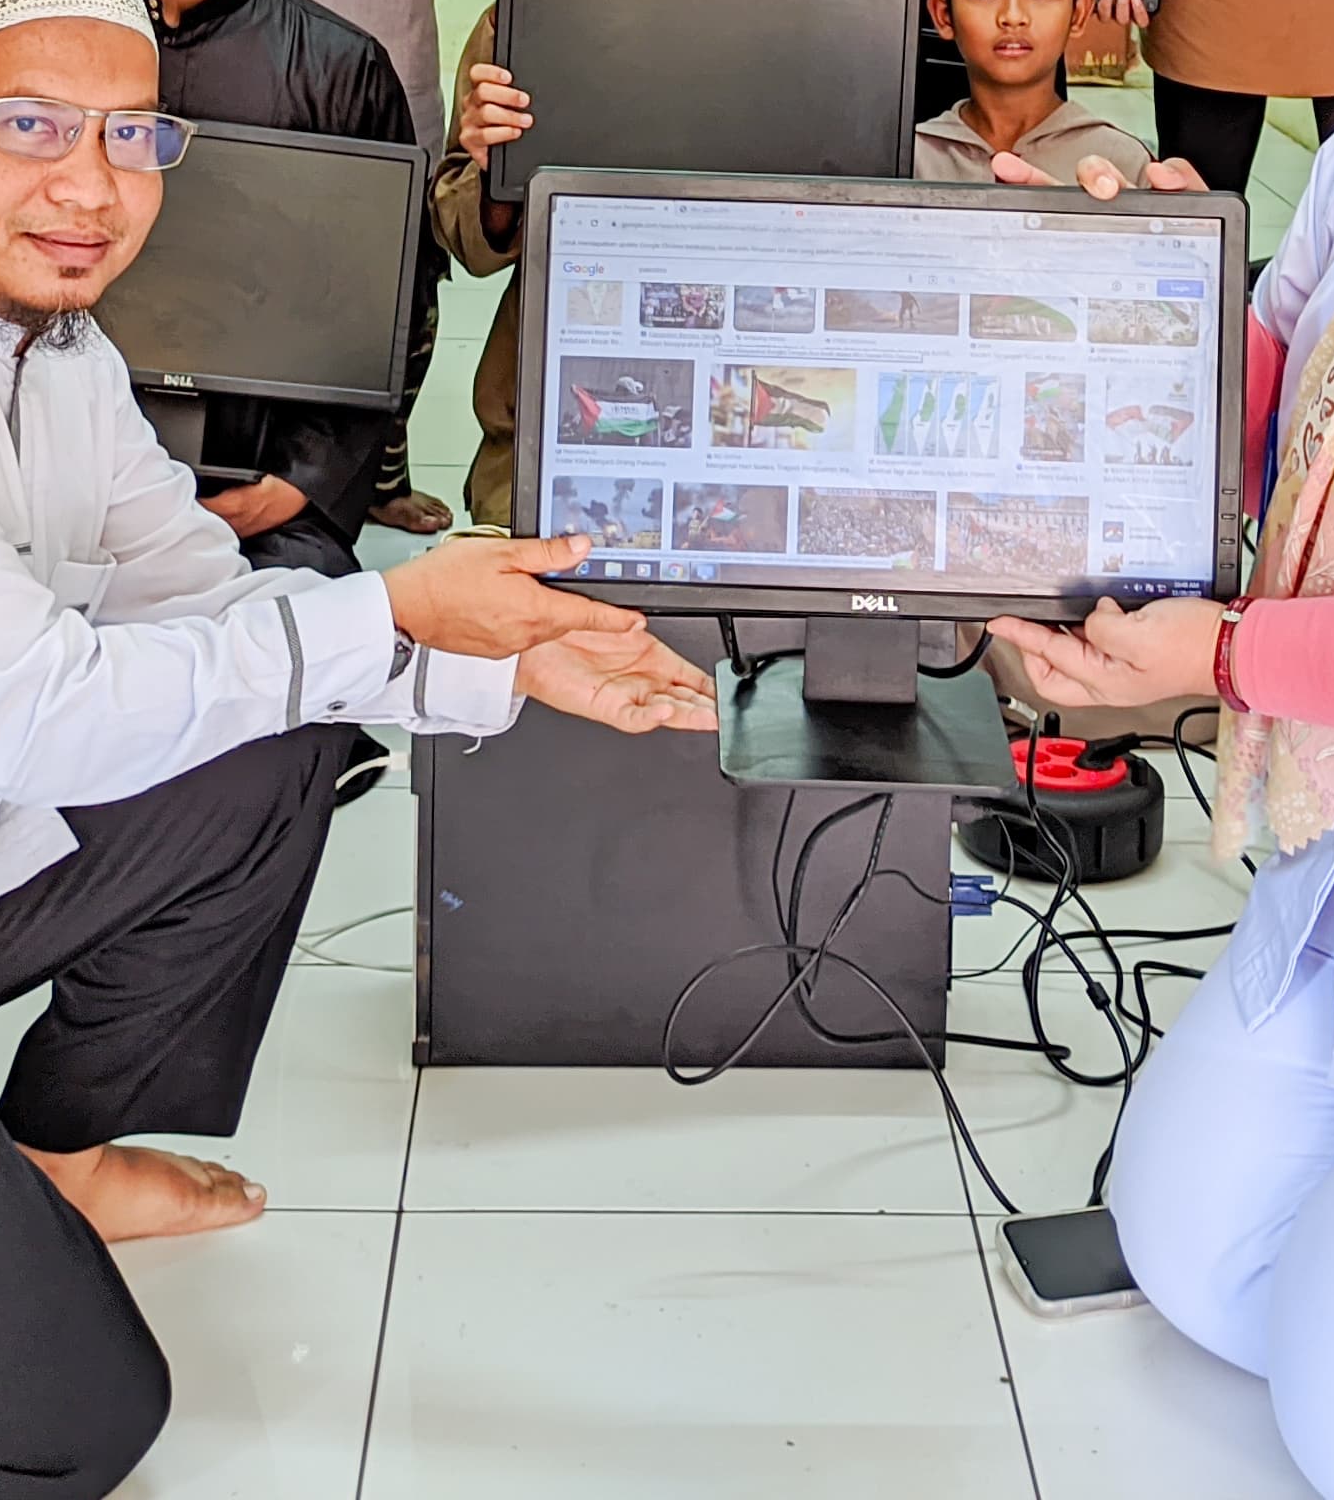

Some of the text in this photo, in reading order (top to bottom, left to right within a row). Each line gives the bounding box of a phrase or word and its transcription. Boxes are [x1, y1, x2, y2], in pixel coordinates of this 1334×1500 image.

[563, 261, 605, 277] Google
[164, 373, 194, 388] DELL
[851, 594, 898, 612] DELL
